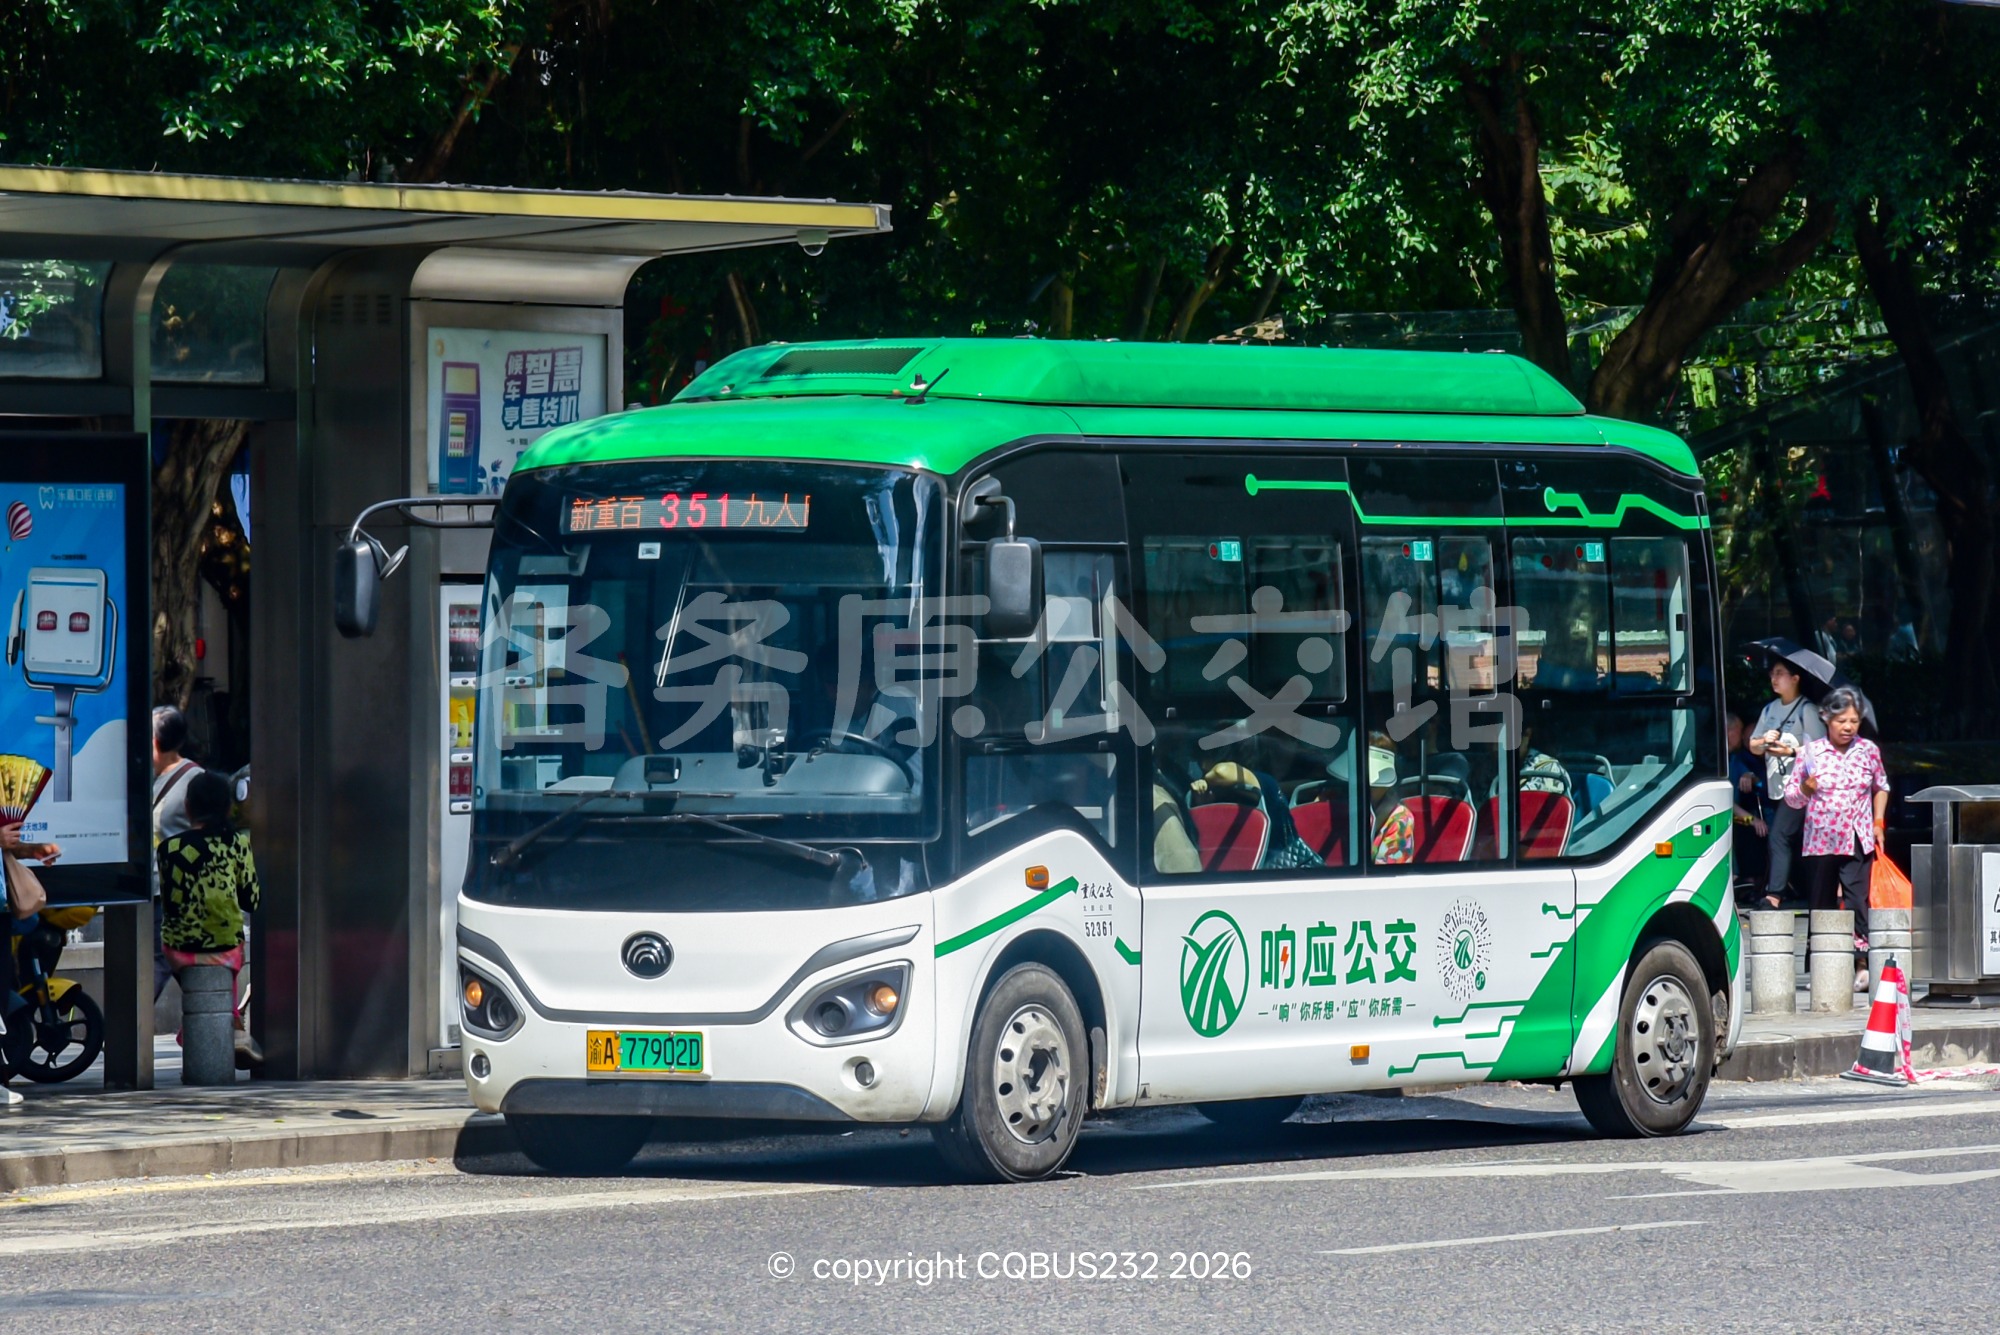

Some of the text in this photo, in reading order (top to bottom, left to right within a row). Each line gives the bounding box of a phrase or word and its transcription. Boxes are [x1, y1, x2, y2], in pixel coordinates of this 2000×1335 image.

[503, 353, 524, 428] 候车亭
[526, 350, 580, 395] 智慧
[521, 395, 578, 427] 售货机
[570, 497, 645, 531] 新重百
[659, 493, 729, 529] 351
[1085, 921, 1113, 937] 52361
[1260, 918, 1416, 990] 响应公交
